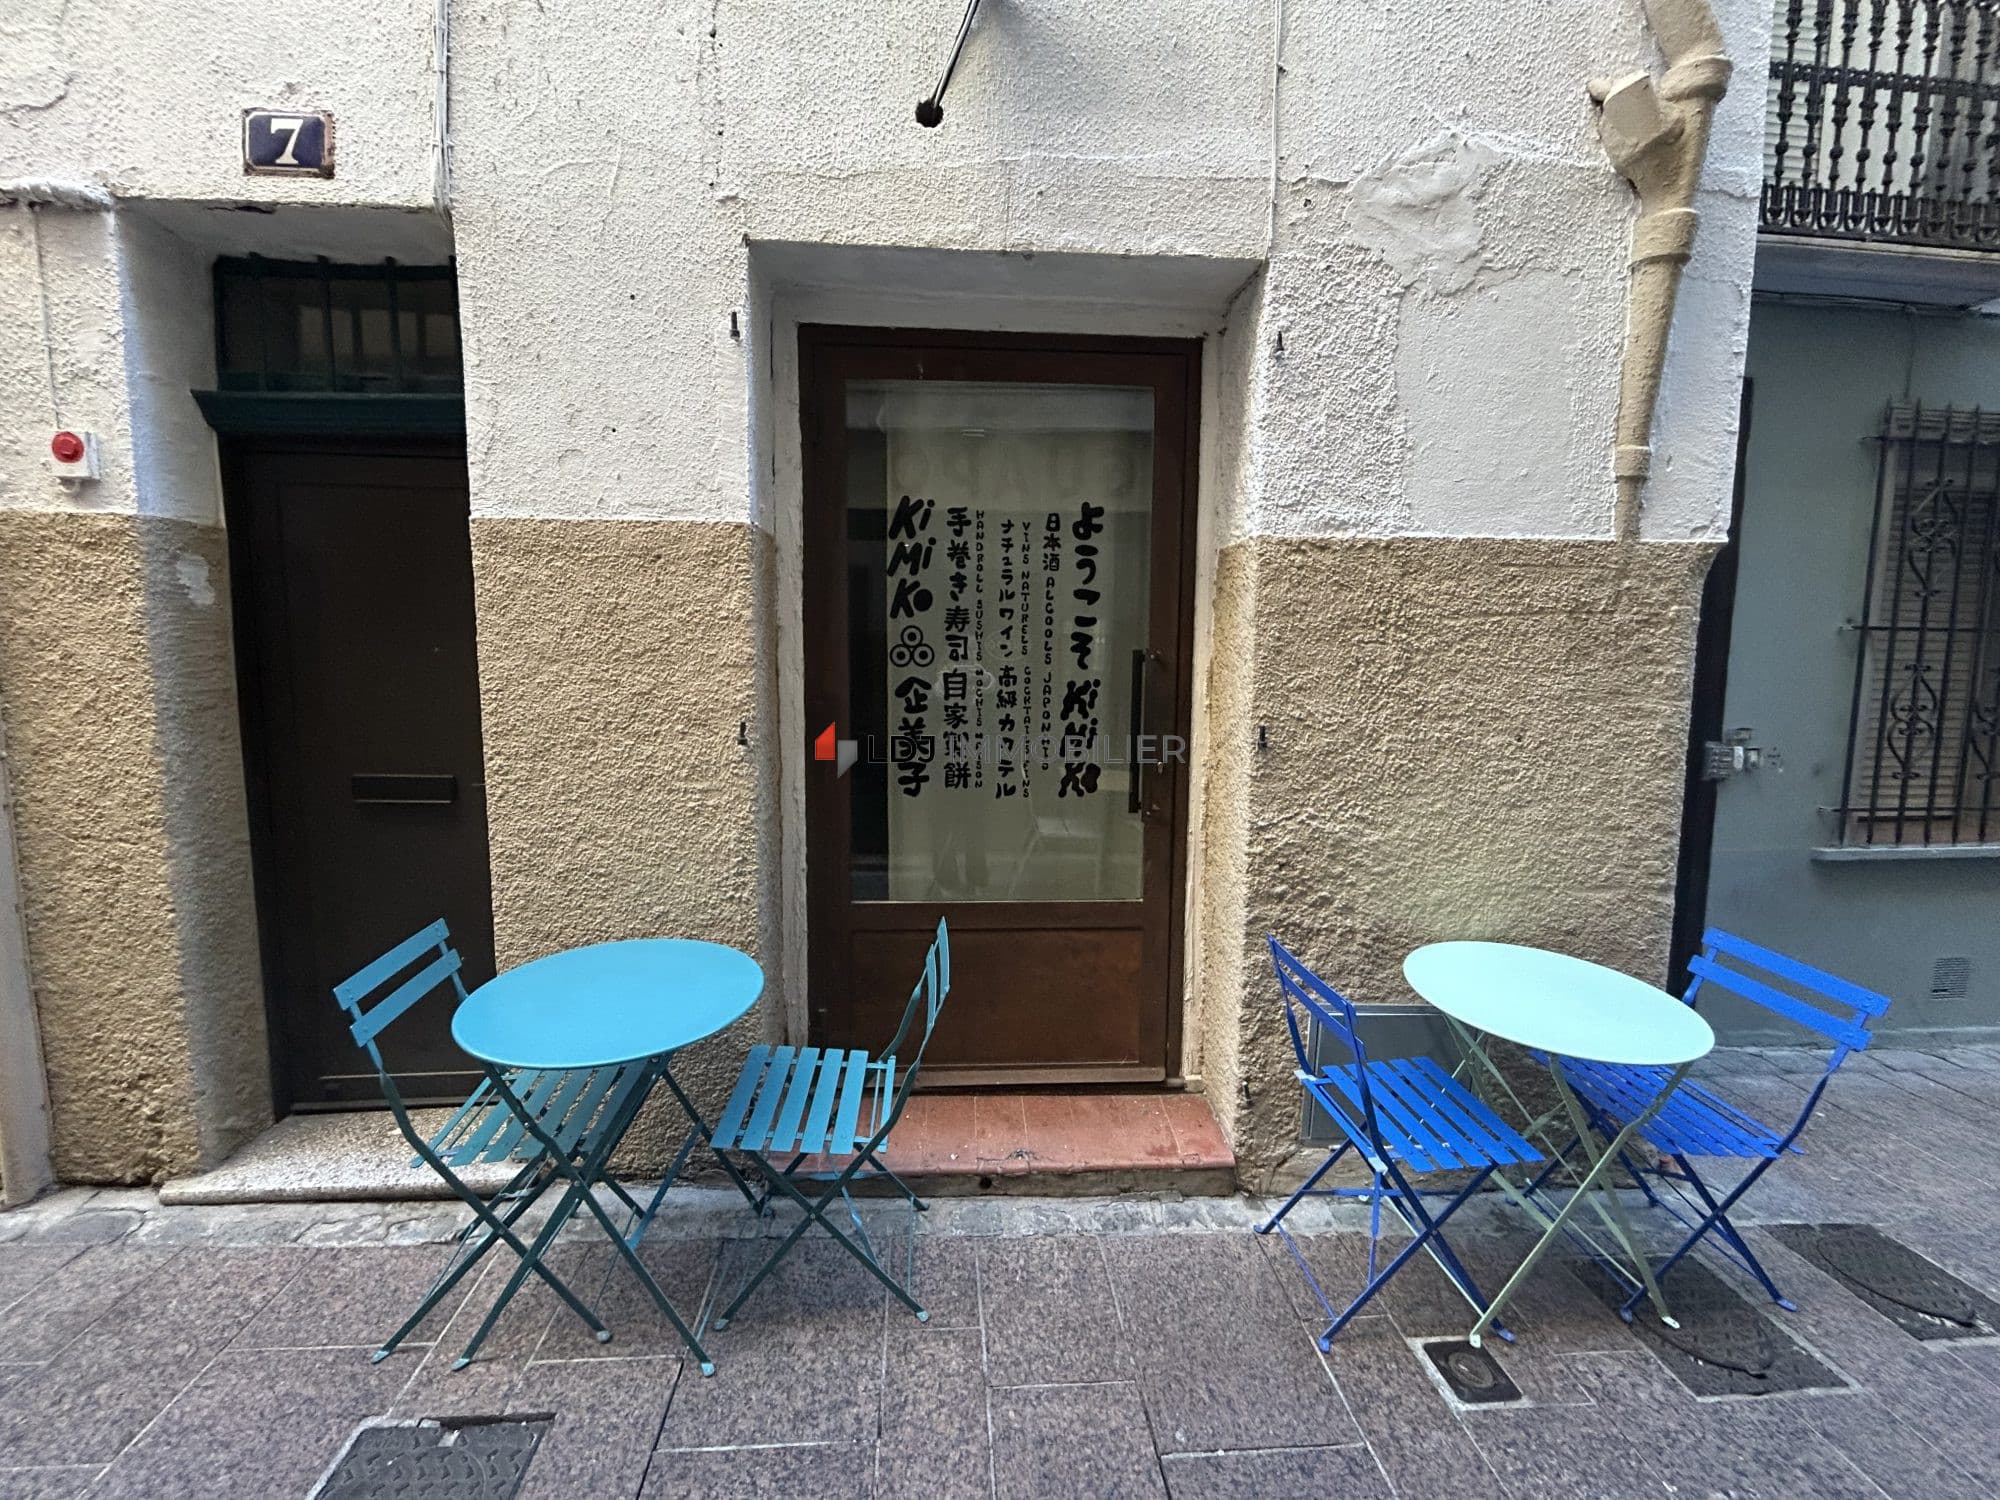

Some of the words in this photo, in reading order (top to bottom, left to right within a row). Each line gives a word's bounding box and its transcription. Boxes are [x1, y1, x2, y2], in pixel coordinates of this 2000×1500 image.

[270, 117, 304, 165] 7
[944, 506, 972, 662] 手巻き寿司
[975, 509, 985, 594] HANDROLL
[1021, 521, 1031, 565] VINS
[1042, 512, 1062, 572] 日本酒
[998, 518, 1016, 658] ナチュラルワイン
[1020, 570, 1031, 656] NATURELS
[1043, 576, 1056, 666] ALCOOLS
[1070, 501, 1105, 671] ようこそ
[974, 599, 984, 662] SUSHIS
[975, 669, 984, 727] MOCHIS
